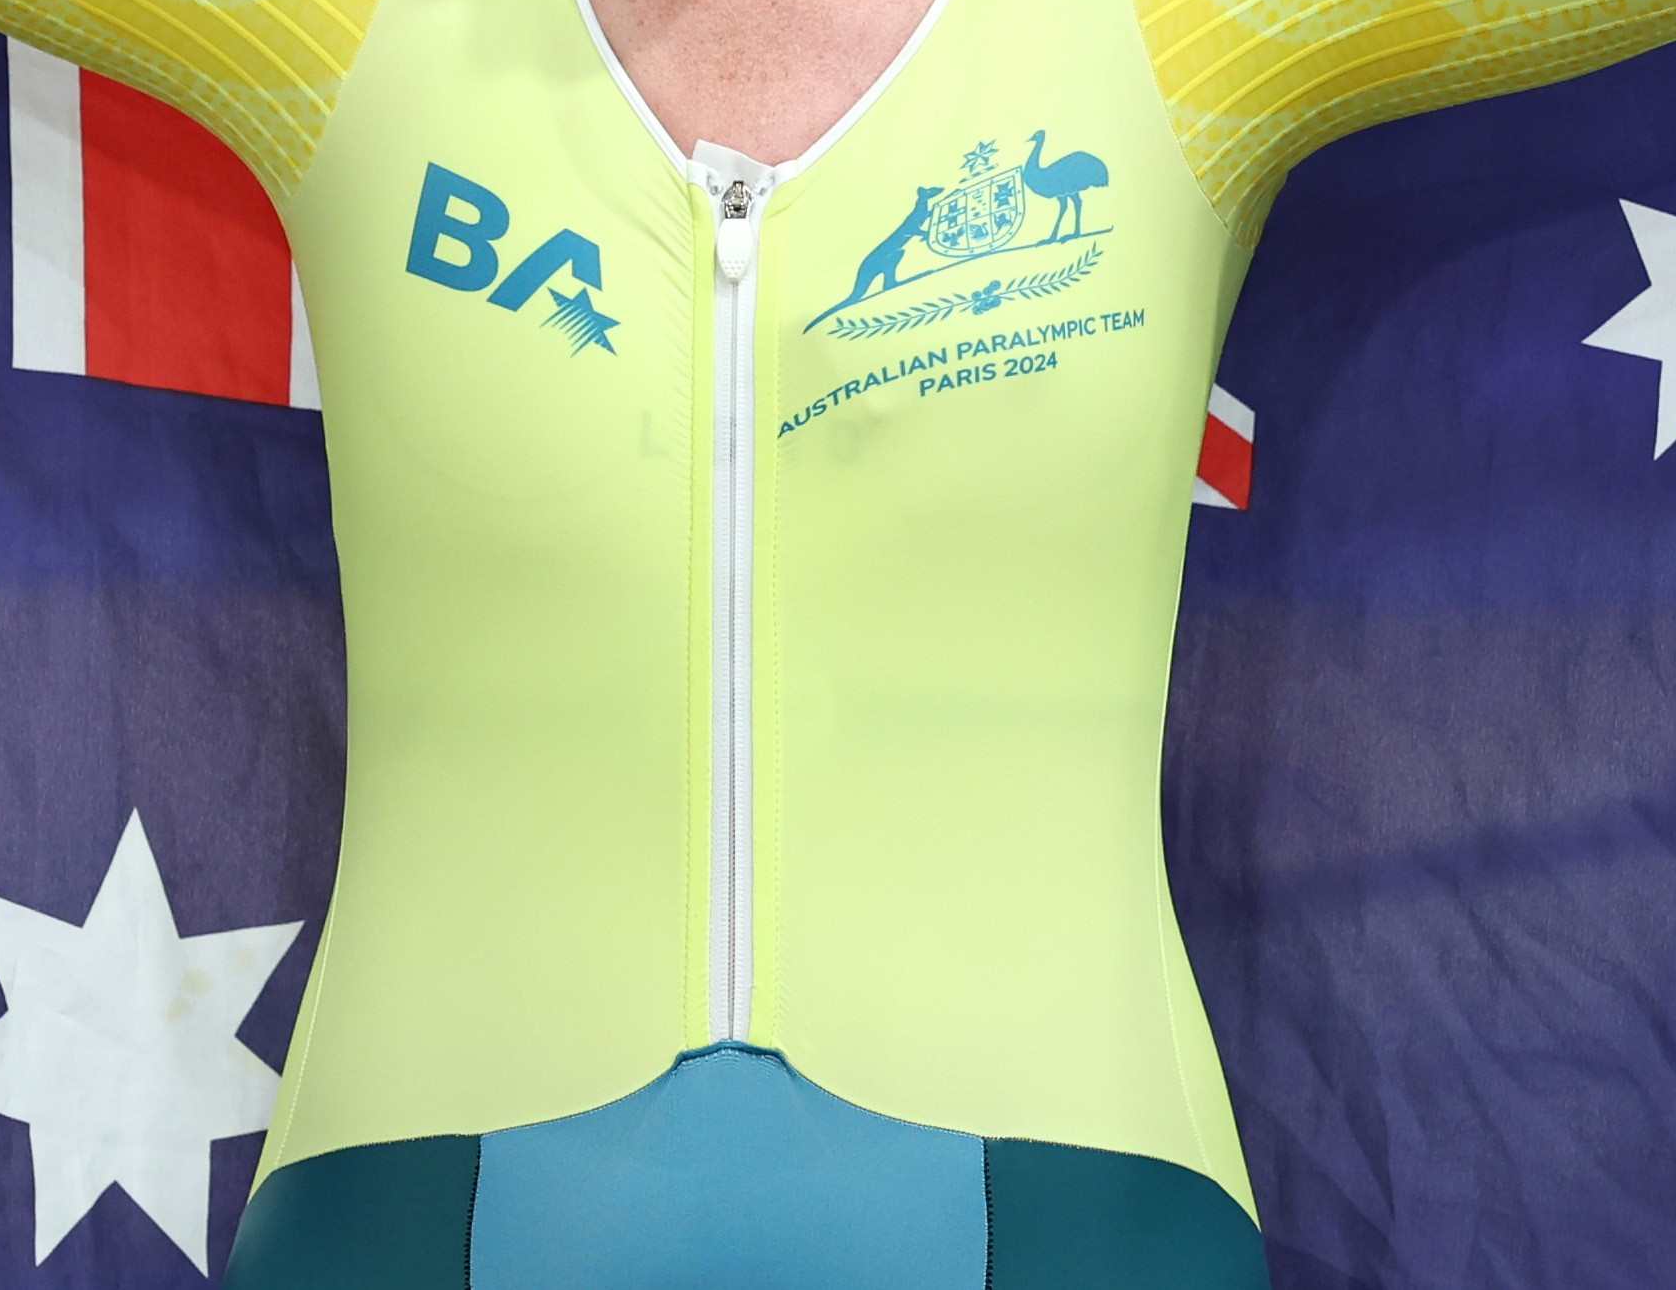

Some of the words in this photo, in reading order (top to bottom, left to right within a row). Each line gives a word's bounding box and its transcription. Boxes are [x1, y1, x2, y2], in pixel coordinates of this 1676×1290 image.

[405, 161, 605, 313] BA
[776, 346, 949, 439] AUSTRALIAN
[955, 316, 1097, 360] PARALYMPIC
[1101, 308, 1146, 335] TEAM
[918, 363, 997, 398] PARIS
[1003, 351, 1059, 379] 2024
